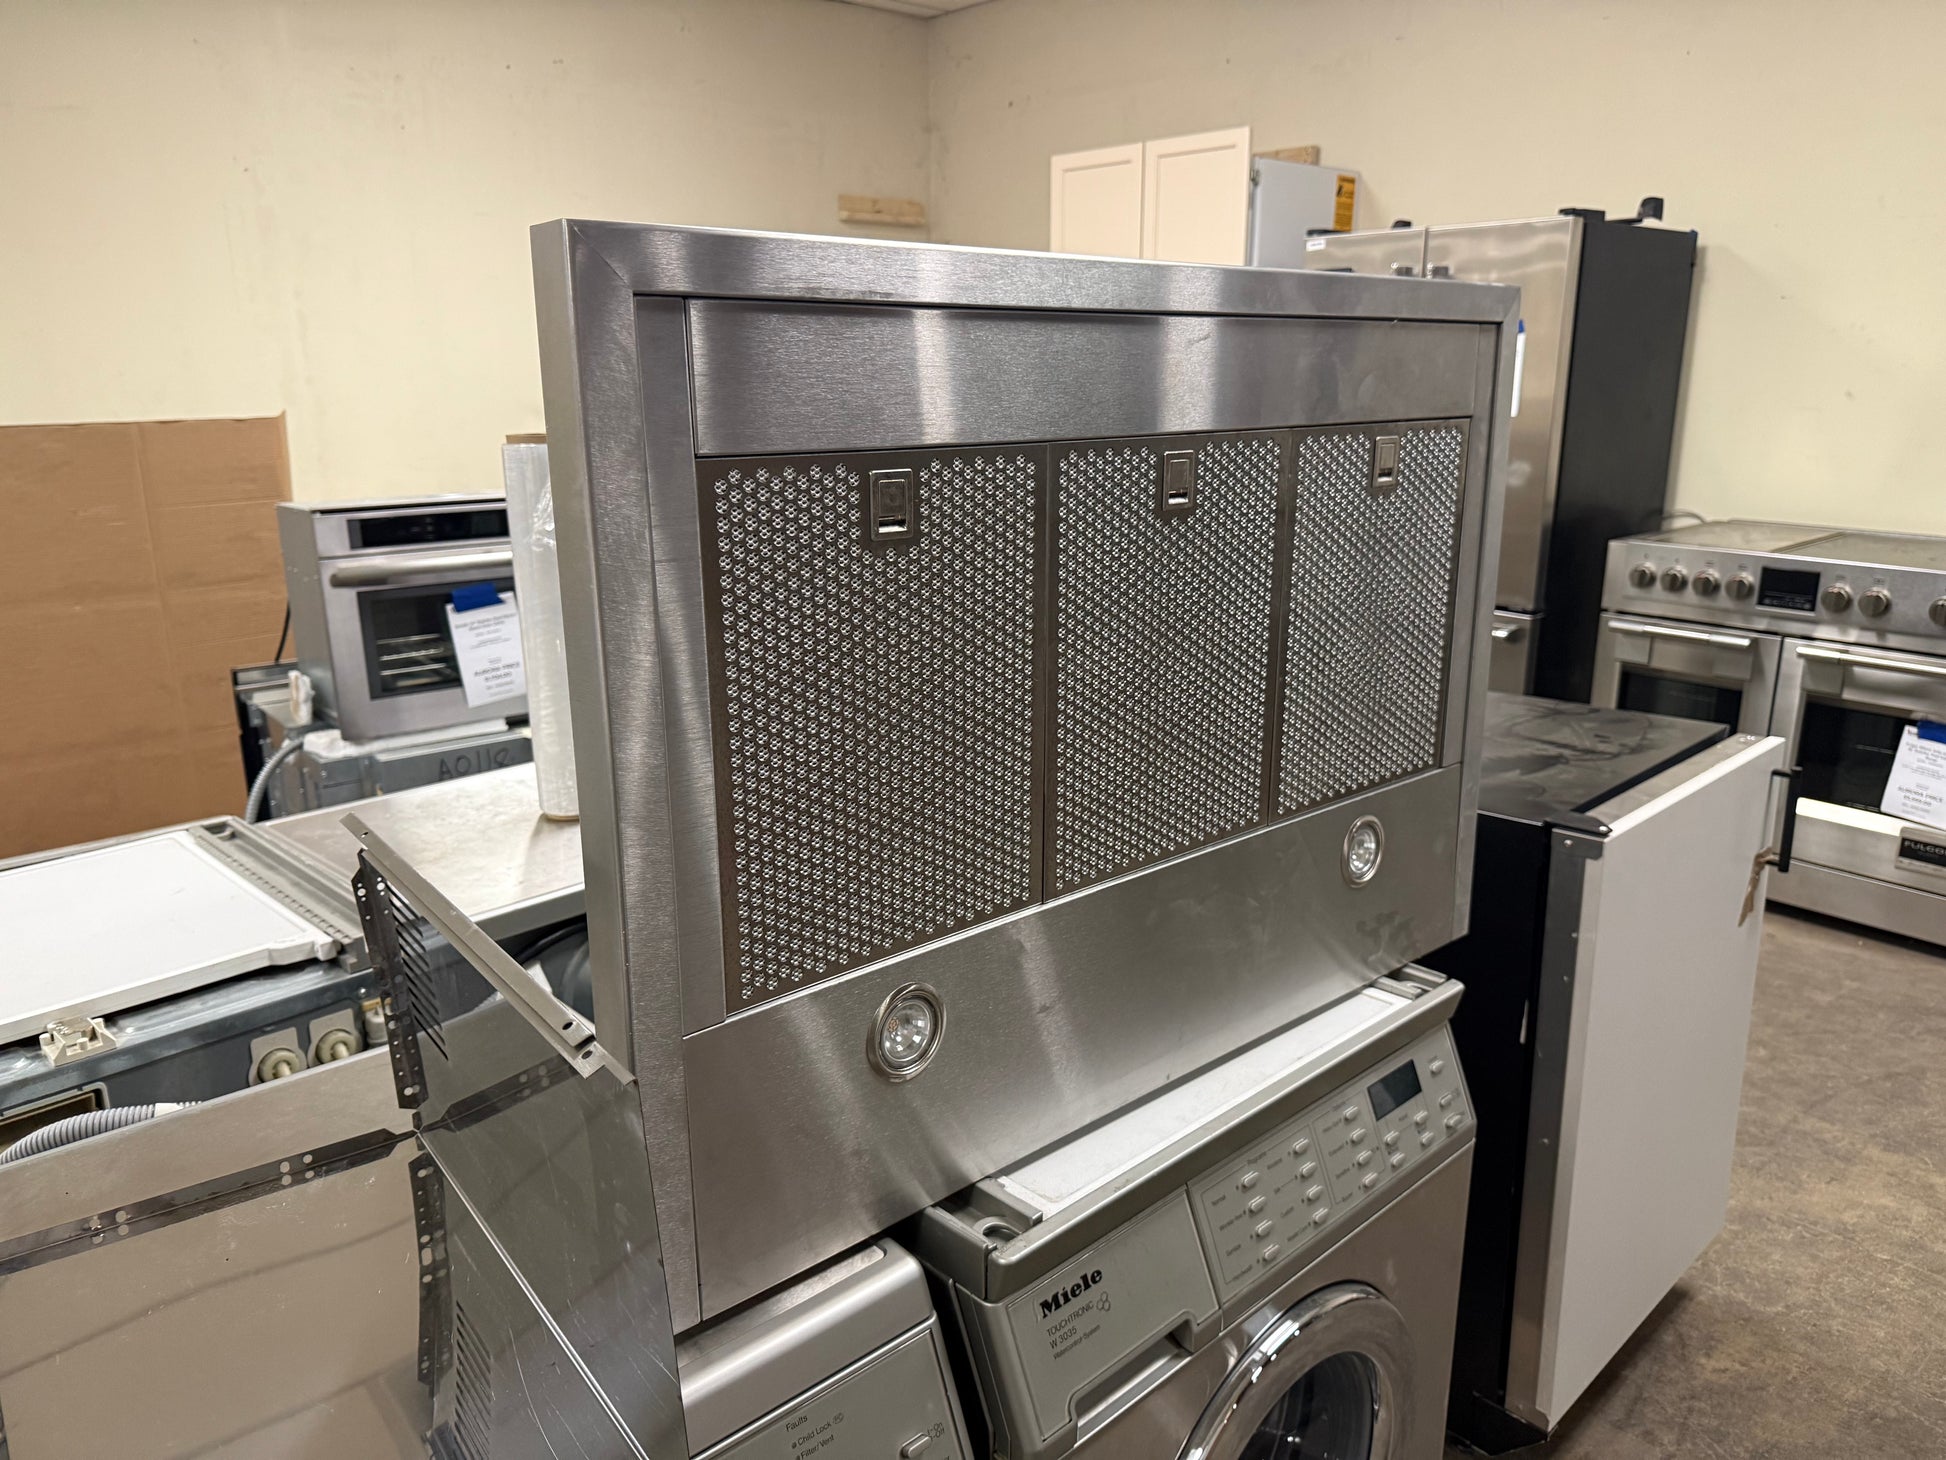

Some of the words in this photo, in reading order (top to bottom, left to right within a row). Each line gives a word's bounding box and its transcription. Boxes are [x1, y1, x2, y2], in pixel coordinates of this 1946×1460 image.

[1903, 840, 1946, 856] FULGO
[1040, 1269, 1102, 1319] Miele
[1046, 1300, 1095, 1337] TOUCHTRONIC
[1049, 1337, 1058, 1350] W
[1058, 1325, 1078, 1344] 3035
[785, 1414, 808, 1432] Faults
[797, 1430, 816, 1447] Child
[815, 1421, 833, 1437] Lock
[819, 1433, 835, 1449] Vent
